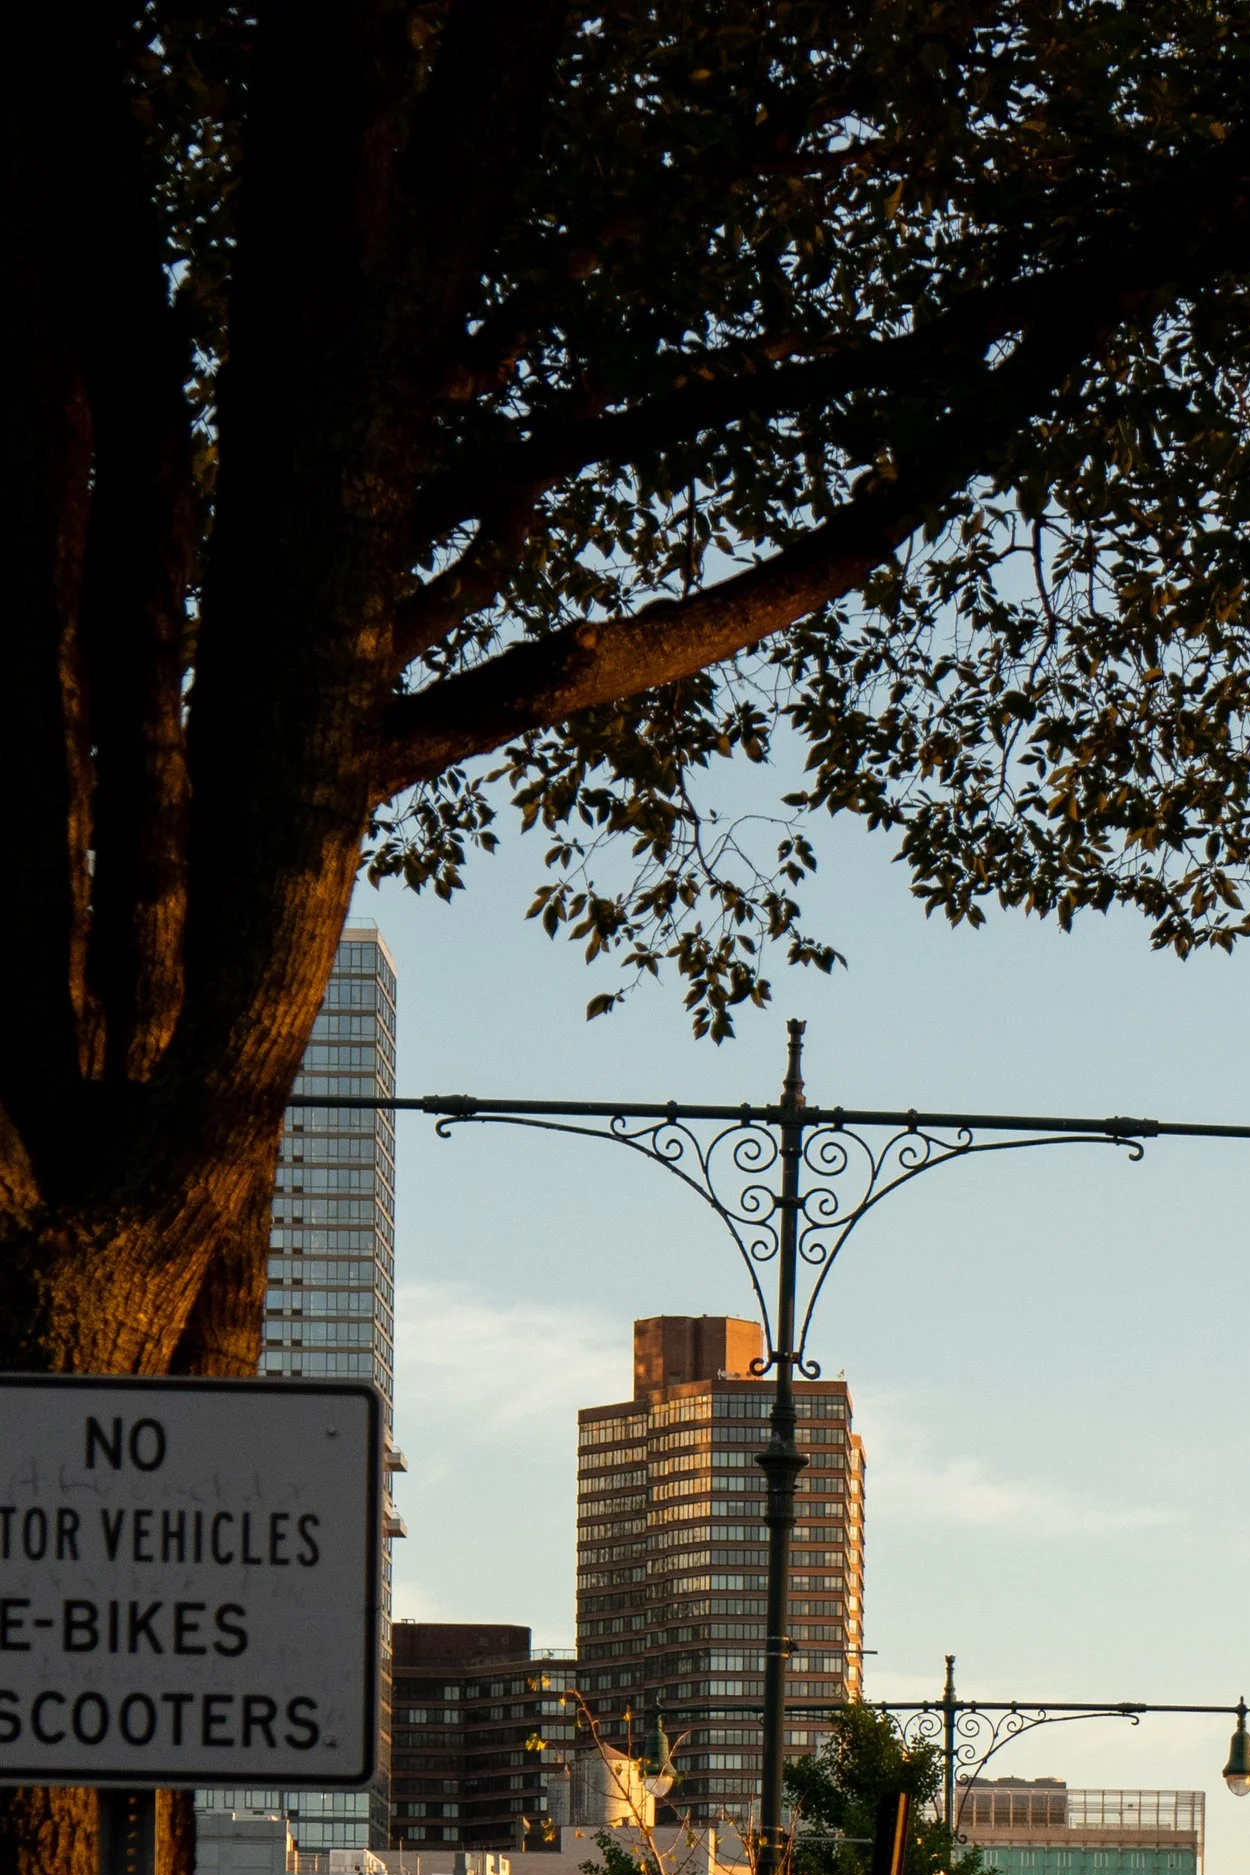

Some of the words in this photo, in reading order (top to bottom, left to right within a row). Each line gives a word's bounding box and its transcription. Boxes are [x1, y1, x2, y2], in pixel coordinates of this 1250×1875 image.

[85, 1416, 167, 1471] NO
[103, 1508, 320, 1567] VEHICLES
[0, 1598, 249, 1657] E-BIKES
[0, 1690, 321, 1750] SCOOTERS
